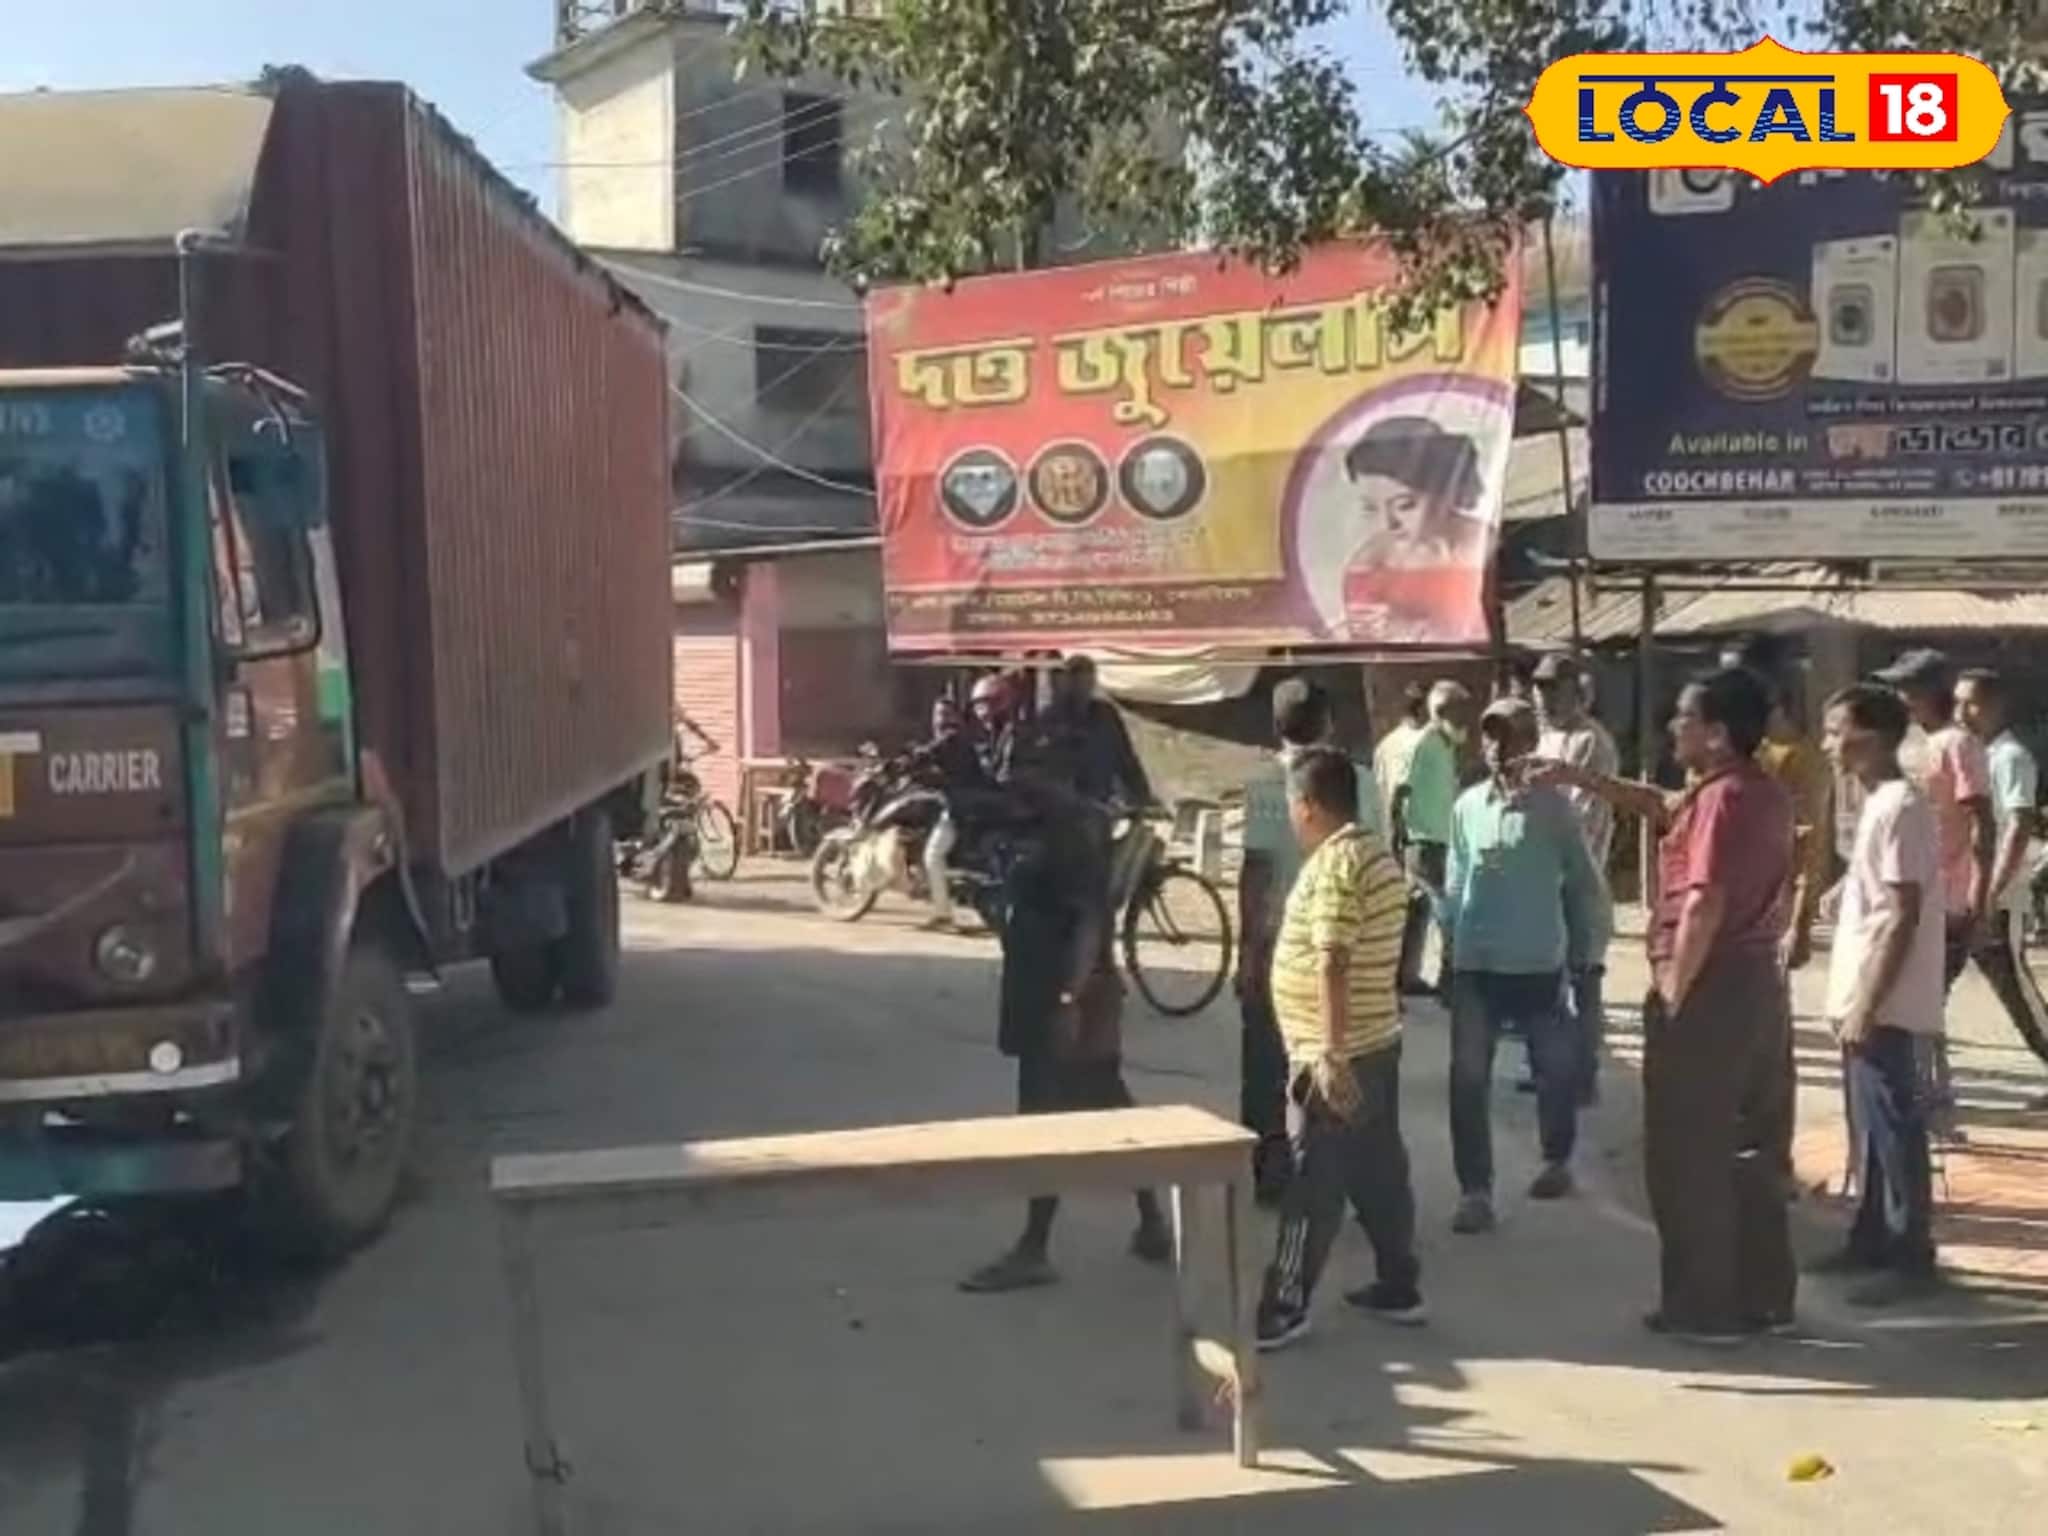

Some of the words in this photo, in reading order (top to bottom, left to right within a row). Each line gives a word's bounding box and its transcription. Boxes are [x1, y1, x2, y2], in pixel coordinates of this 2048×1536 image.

[892, 337, 1035, 410] দত্ত
[1669, 430, 1780, 454] Available
[50, 749, 161, 794] CARRIER
